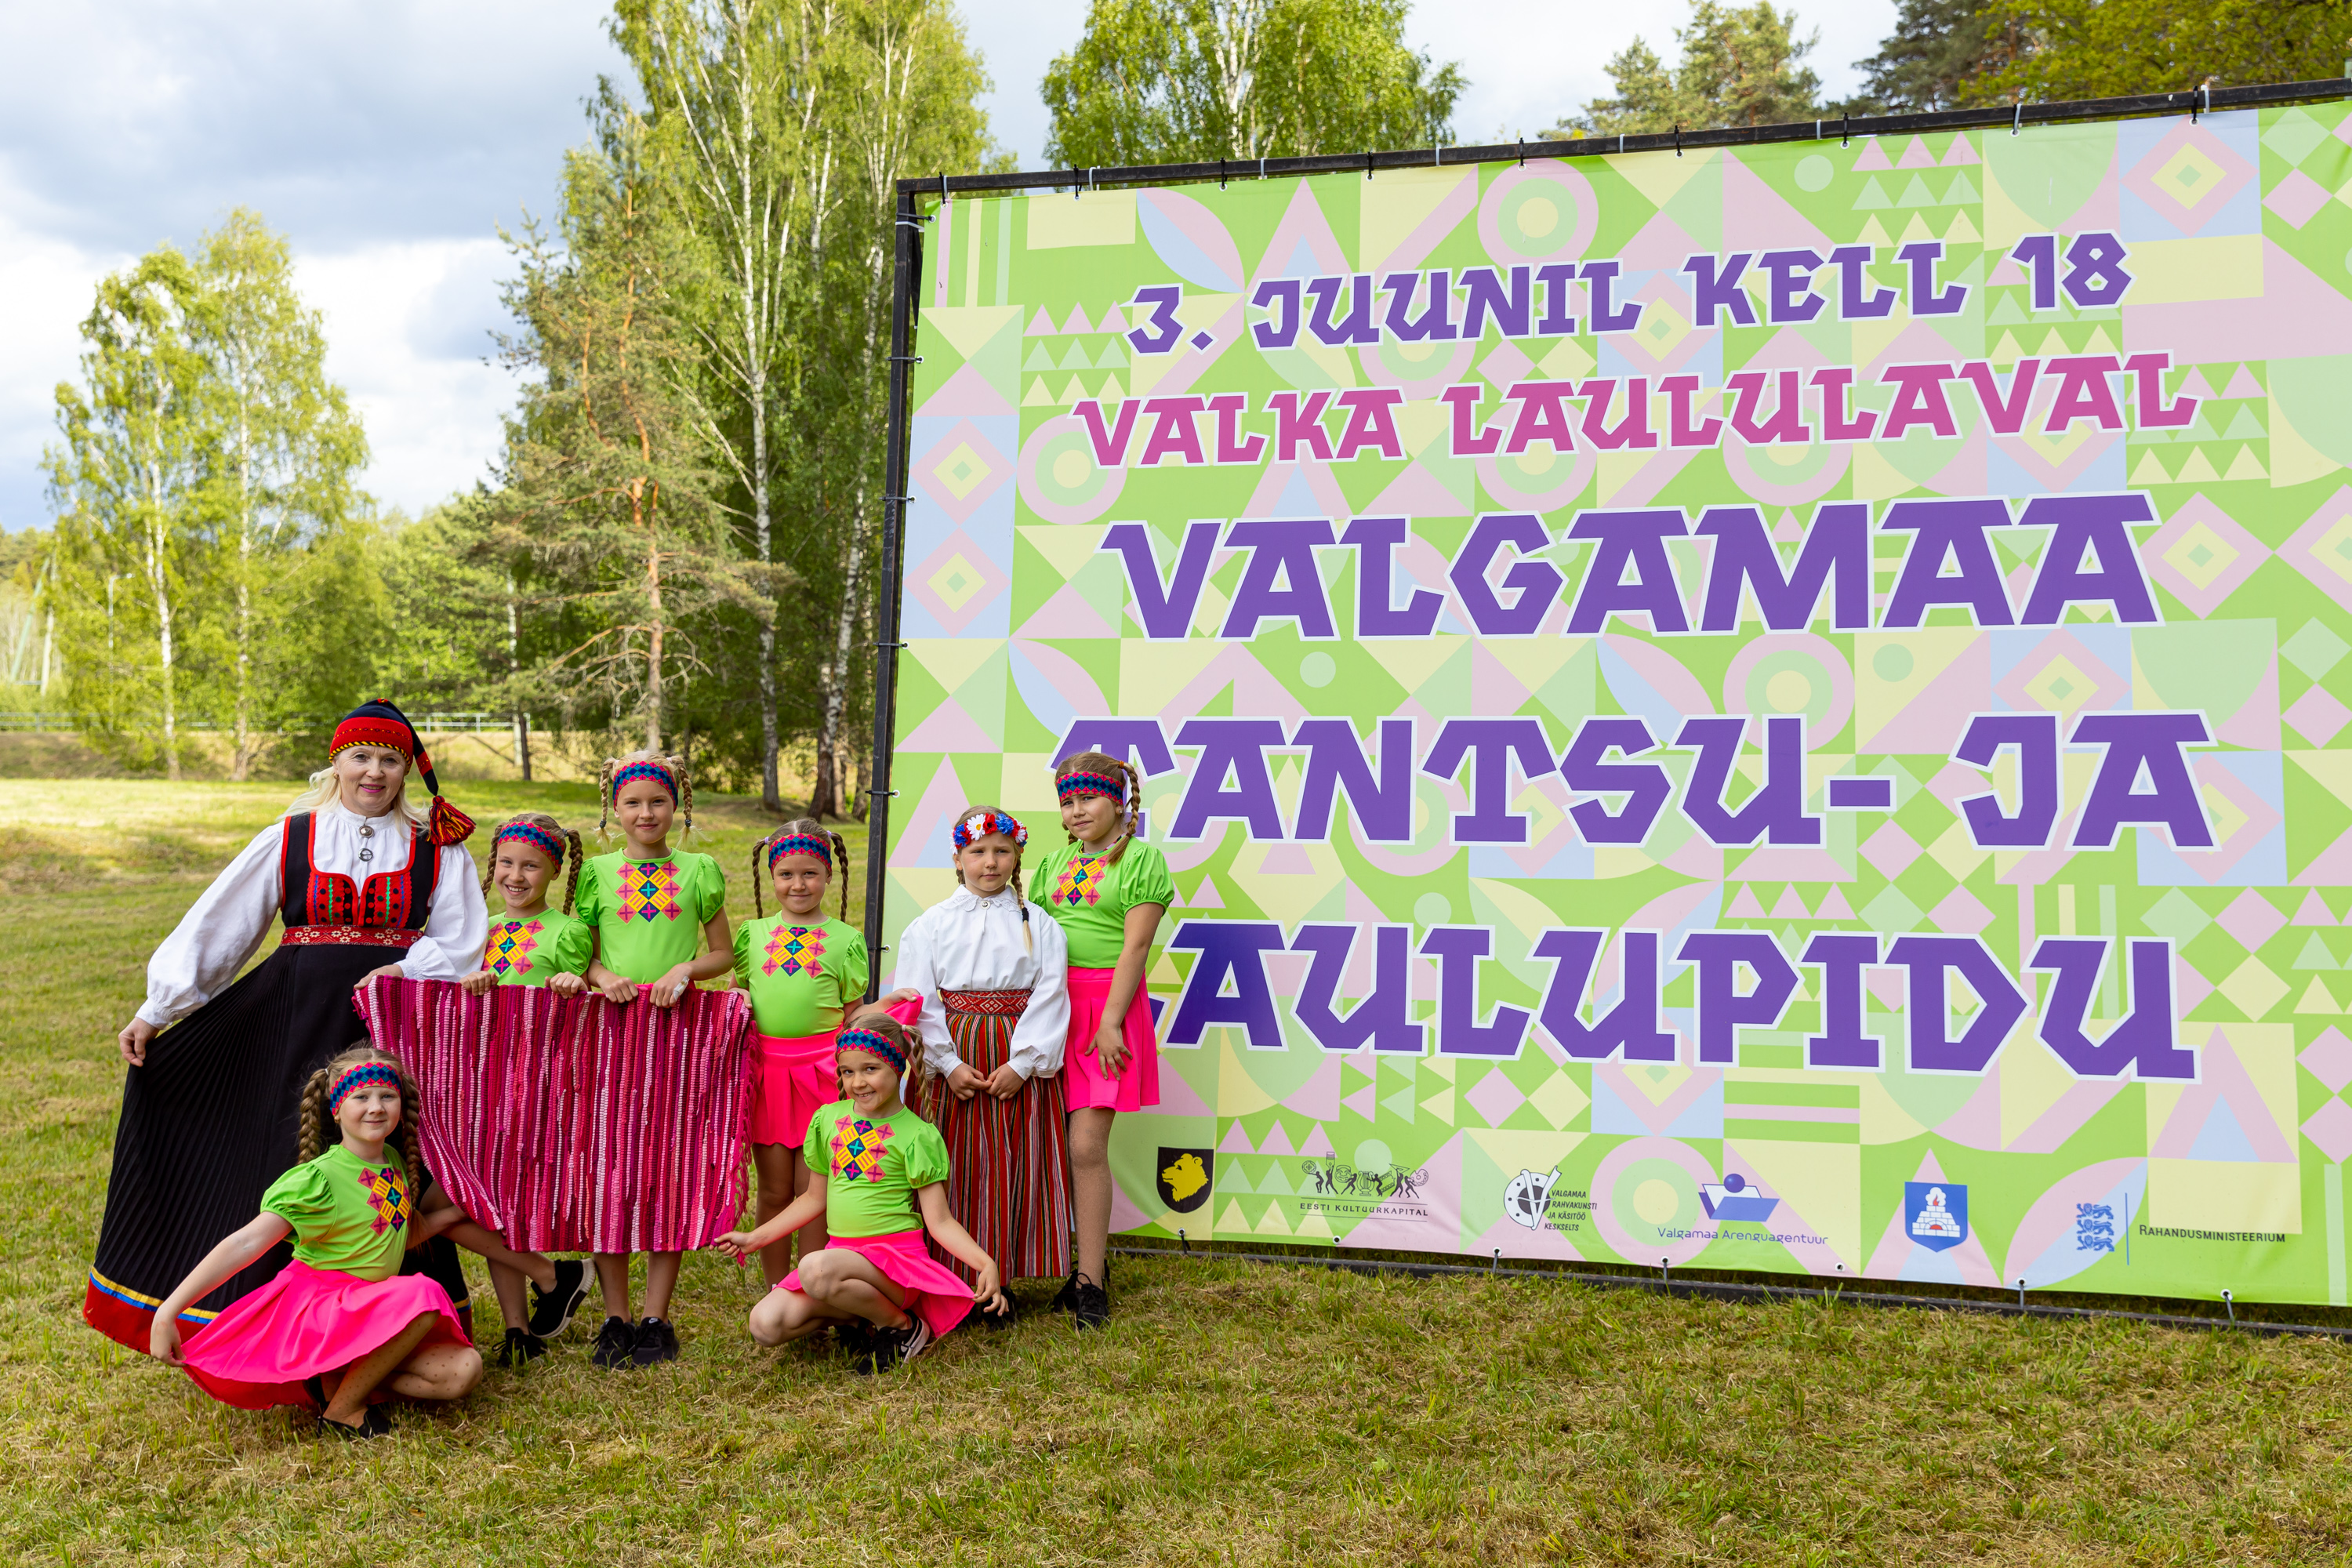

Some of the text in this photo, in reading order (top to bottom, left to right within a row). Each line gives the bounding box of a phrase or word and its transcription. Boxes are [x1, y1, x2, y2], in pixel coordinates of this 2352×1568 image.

[1127, 232, 2132, 354] 3. JUUNIL KELL 18
[1072, 352, 2198, 466] VALKA LAULULAVAL
[1100, 493, 2158, 639] VALGAMAA
[1955, 713, 2214, 848] JA
[1148, 922, 2195, 1080] AULUPIDU
[1551, 1189, 1587, 1199] VALGAMAA
[1299, 1202, 1428, 1217] EESTI KULTUURKAPITAL
[1552, 1200, 1598, 1210] RAHVAKUNSTI
[1547, 1210, 1587, 1221] JA KÄSITÖÖ
[1544, 1222, 1580, 1232] KESKSELTS
[1657, 1226, 1829, 1245] Valgamaa Arenguagentuur
[2139, 1224, 2286, 1243] RAHANDUSMINISTEERIUM
